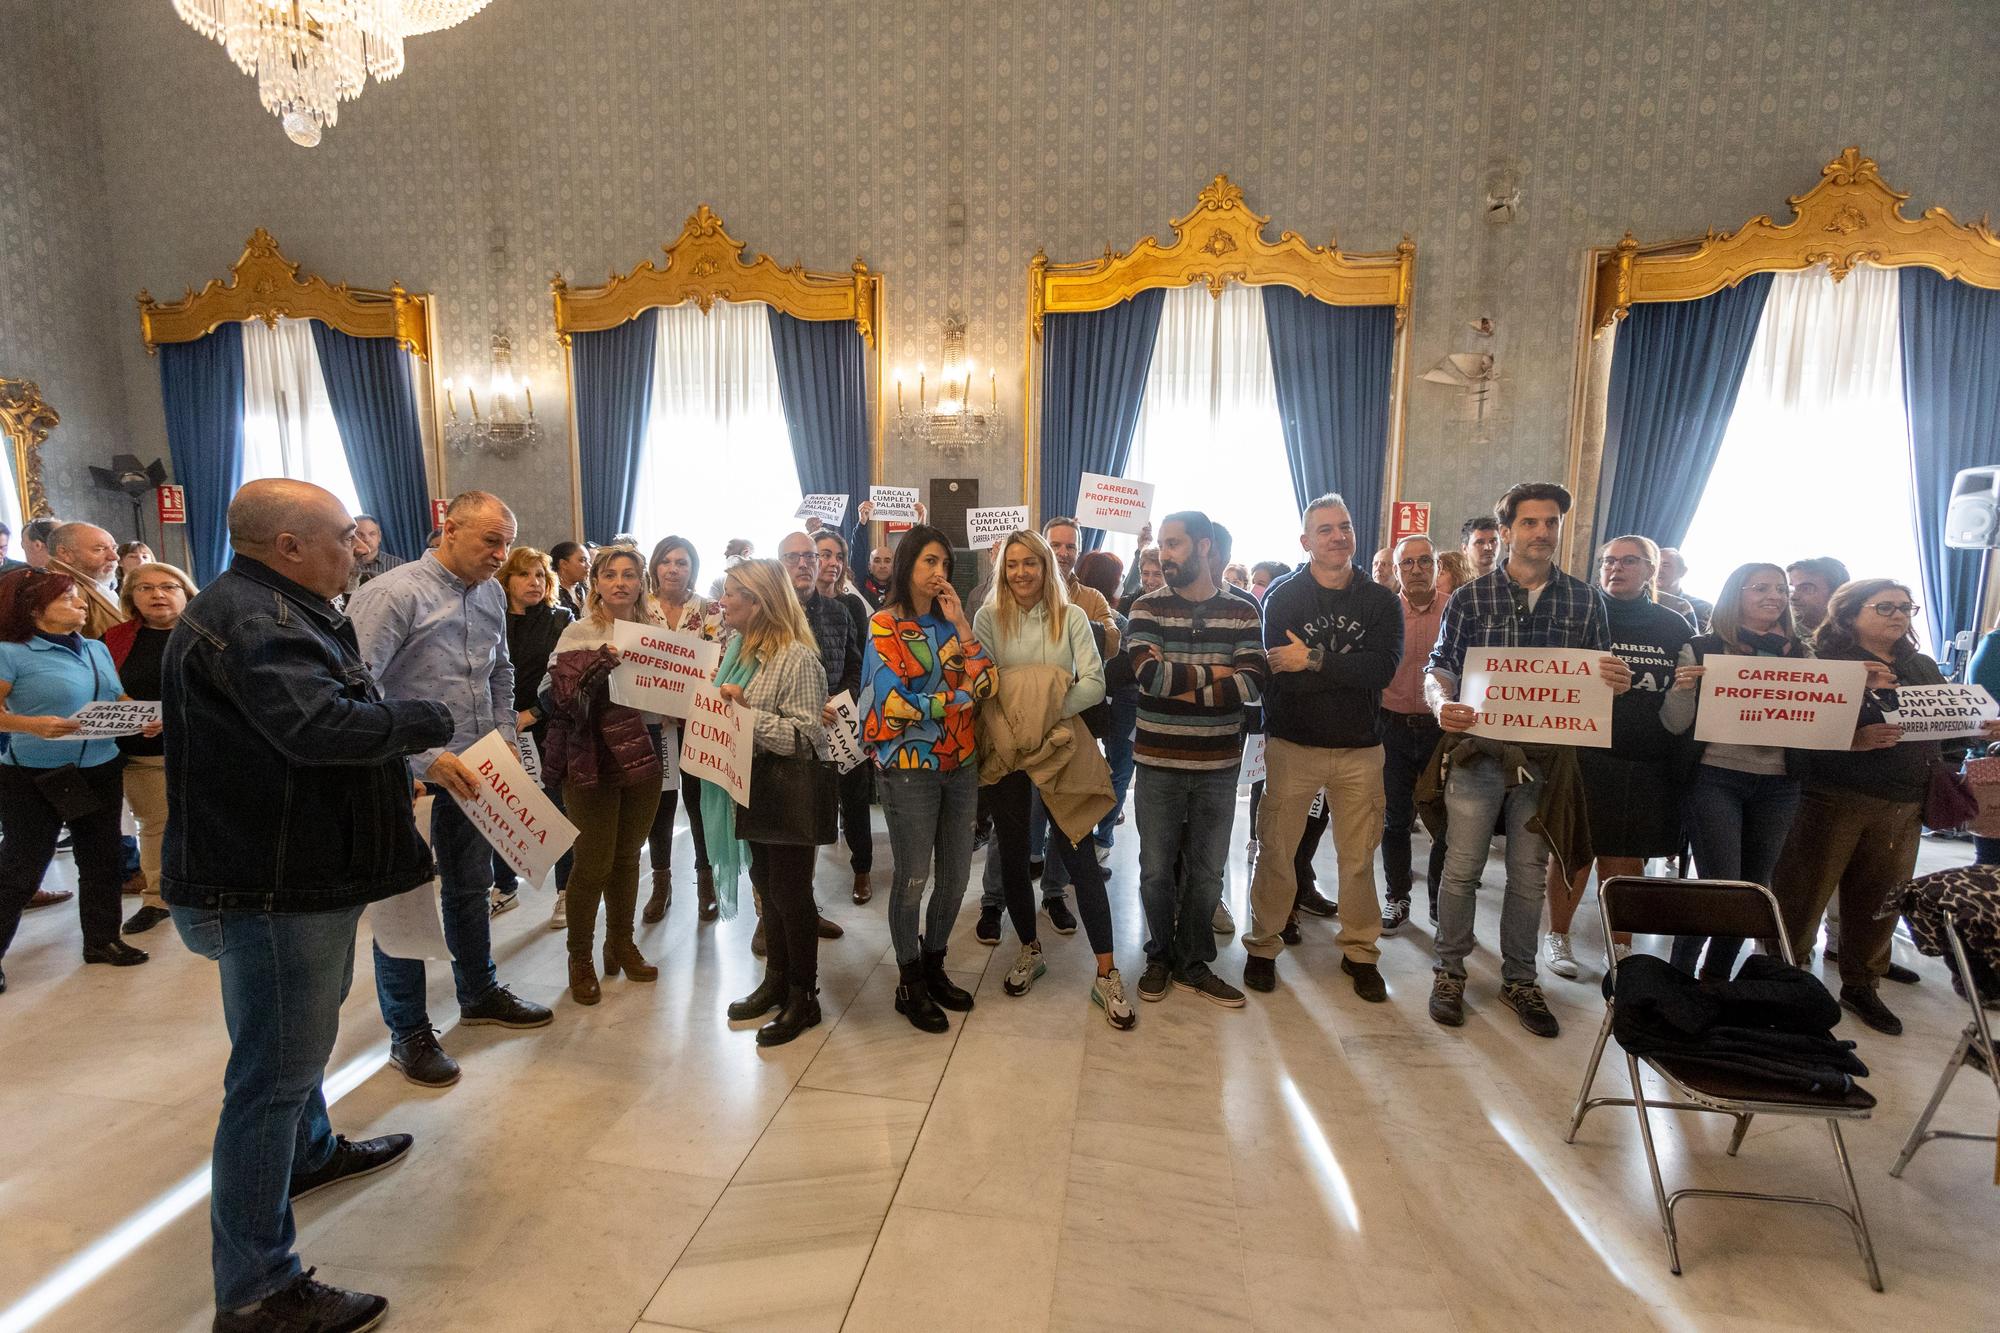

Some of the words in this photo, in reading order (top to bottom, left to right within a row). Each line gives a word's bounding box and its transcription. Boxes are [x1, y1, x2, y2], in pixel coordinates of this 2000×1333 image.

[1097, 483, 1138, 496] CARRERA
[1086, 492, 1146, 508] PROFESIONAL
[805, 504, 837, 513] PALABRA
[640, 636, 696, 660] CARRERA
[1610, 642, 1665, 654] ARRERA
[622, 650, 706, 679] PROFESIONAL
[1485, 658, 1592, 676] BARCALA
[636, 675, 685, 693] ¡¡¡¡YA!!!!
[1738, 669, 1829, 684] CARRERA
[1485, 685, 1581, 704] CUMPLE
[1714, 687, 1847, 704] PROFESIONAL
[1898, 689, 1972, 698] ARCALA
[92, 705, 155, 714] BARCALA
[1899, 698, 1959, 707] UMPLE
[76, 712, 137, 721] CUMPLE
[1740, 708, 1815, 722] ¡¡¡¡YA!!!!
[1899, 707, 1981, 718] PALABRA
[80, 720, 143, 729] PALABRA
[1502, 713, 1599, 732] PALABRA
[1930, 720, 1976, 732] PROFESIONAL
[683, 744, 696, 760] TU
[478, 758, 547, 845] BARCALA
[472, 788, 529, 855] UMPLE
